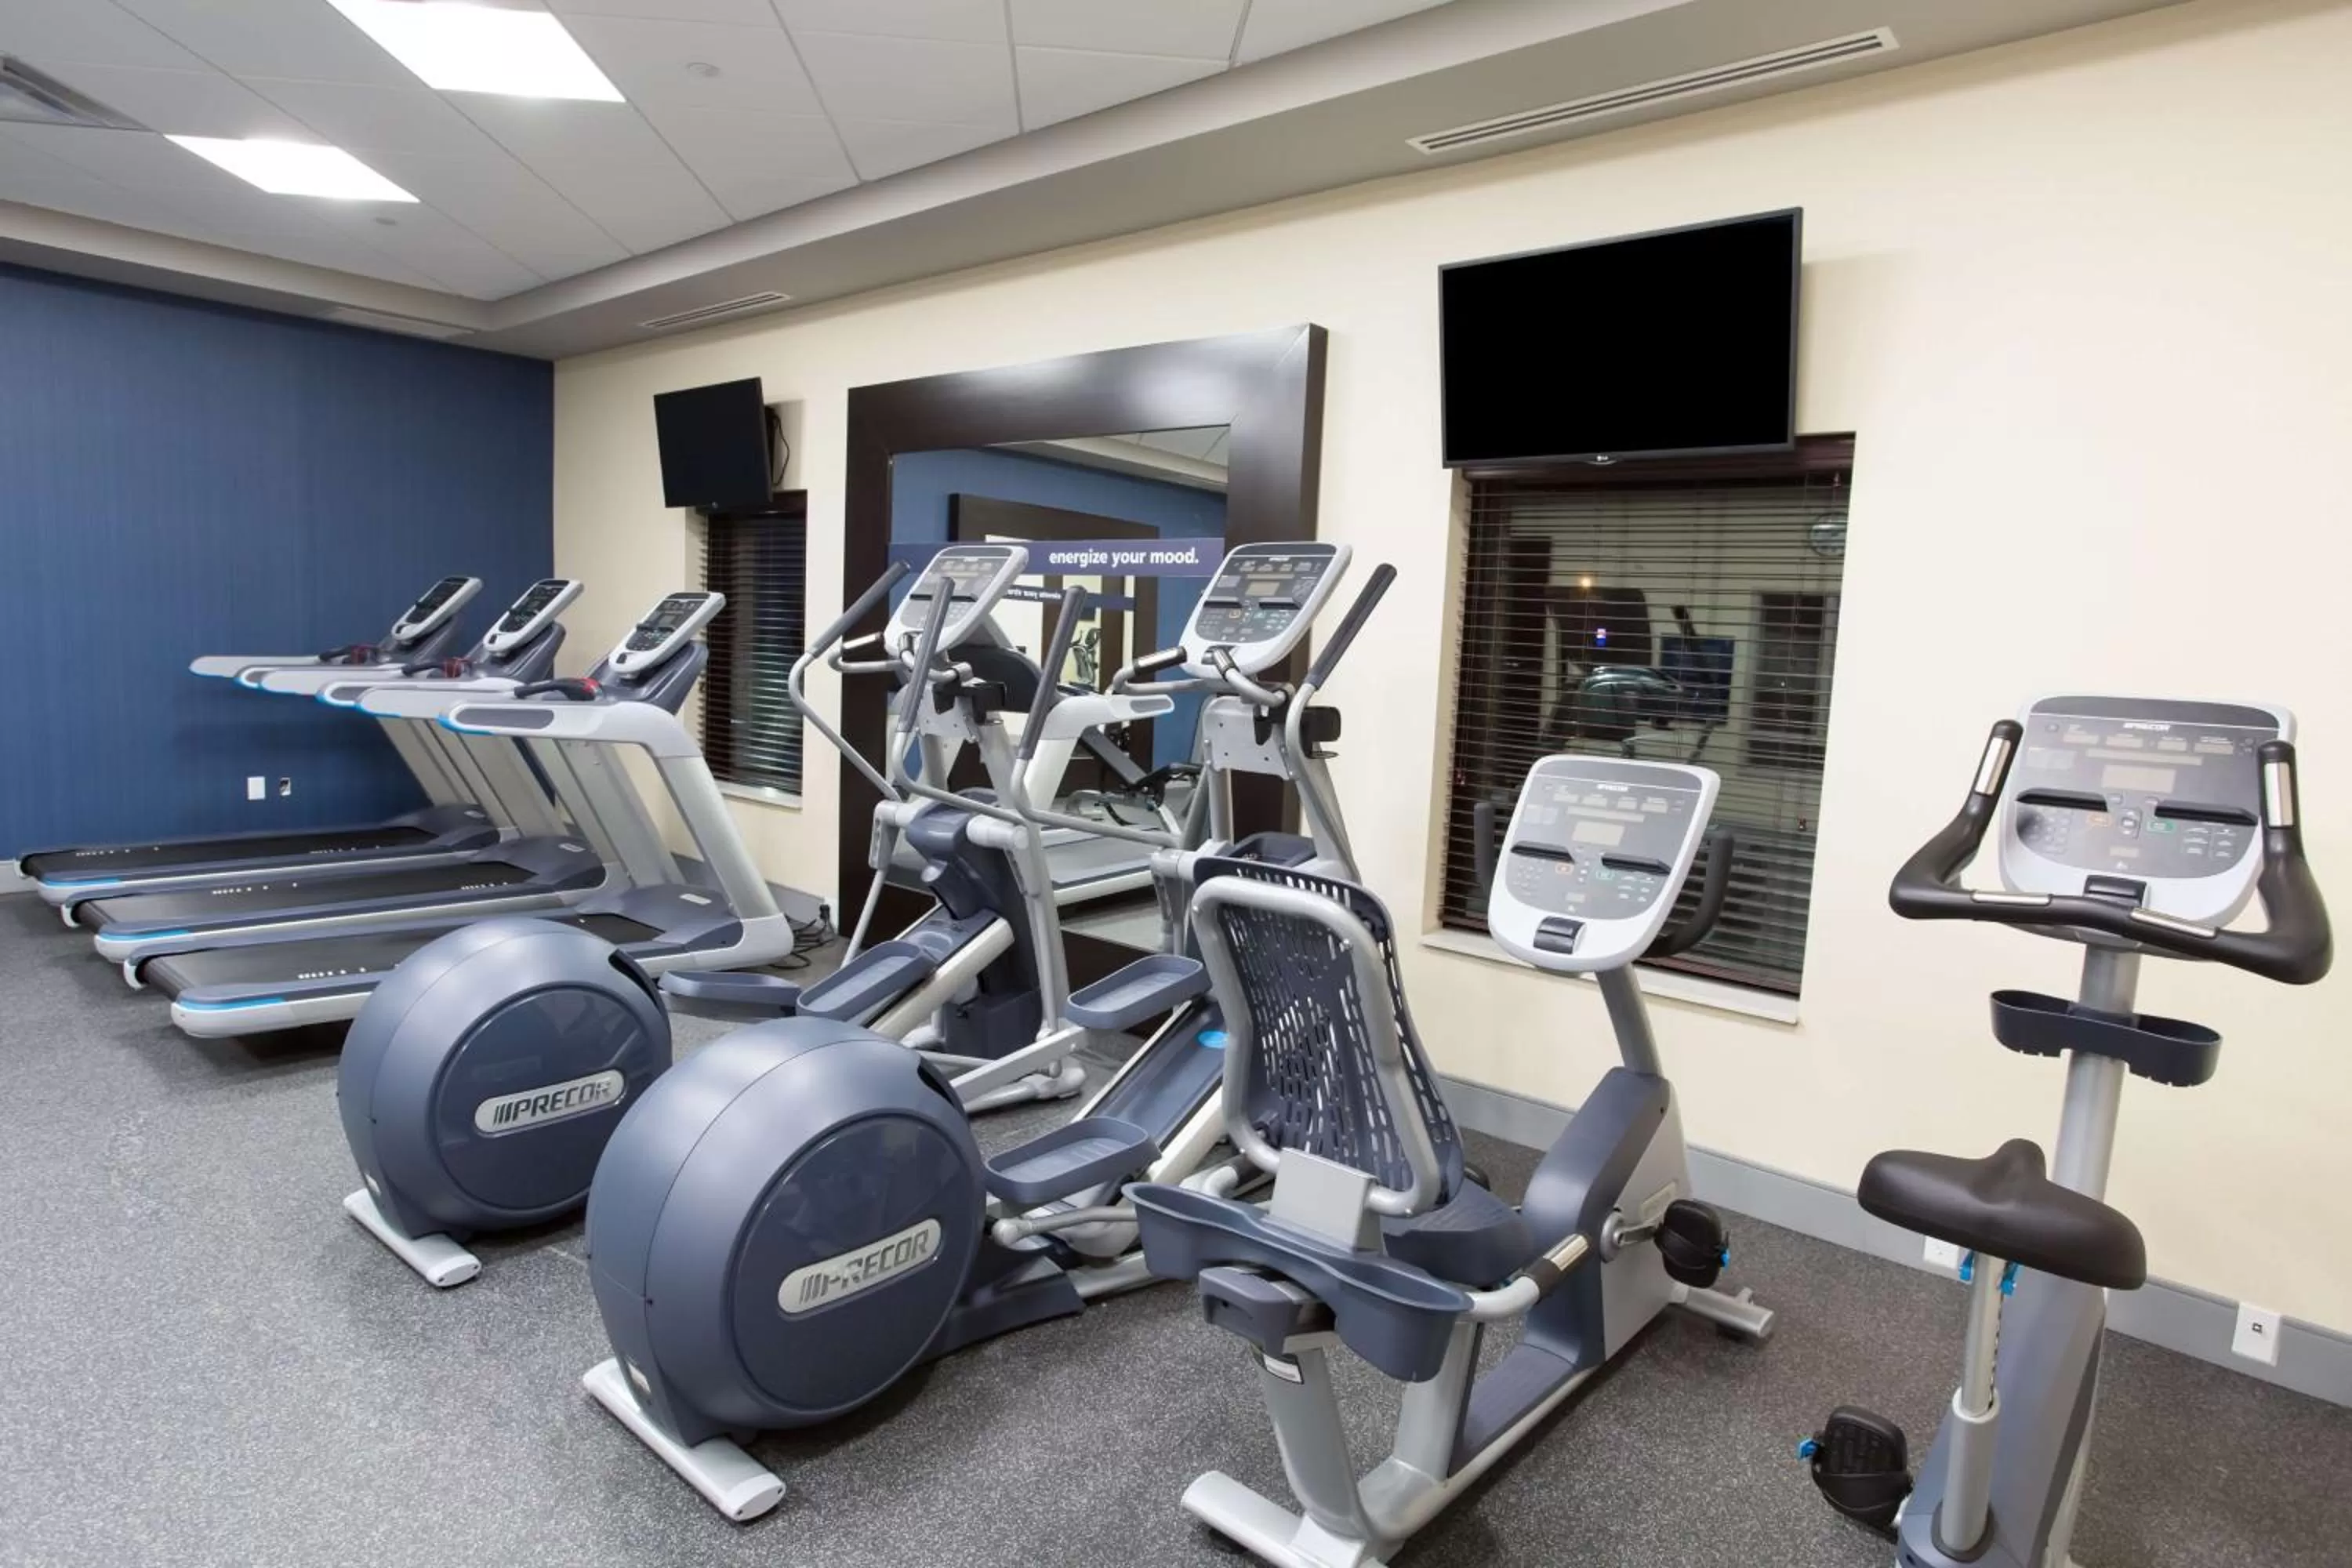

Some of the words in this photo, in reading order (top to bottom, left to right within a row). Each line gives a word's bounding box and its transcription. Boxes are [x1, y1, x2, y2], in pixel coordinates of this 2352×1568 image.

[1049, 548, 1108, 568] energize
[1112, 551, 1147, 568] your
[1150, 546, 1200, 564] mood.
[510, 1078, 612, 1123] PRECOR
